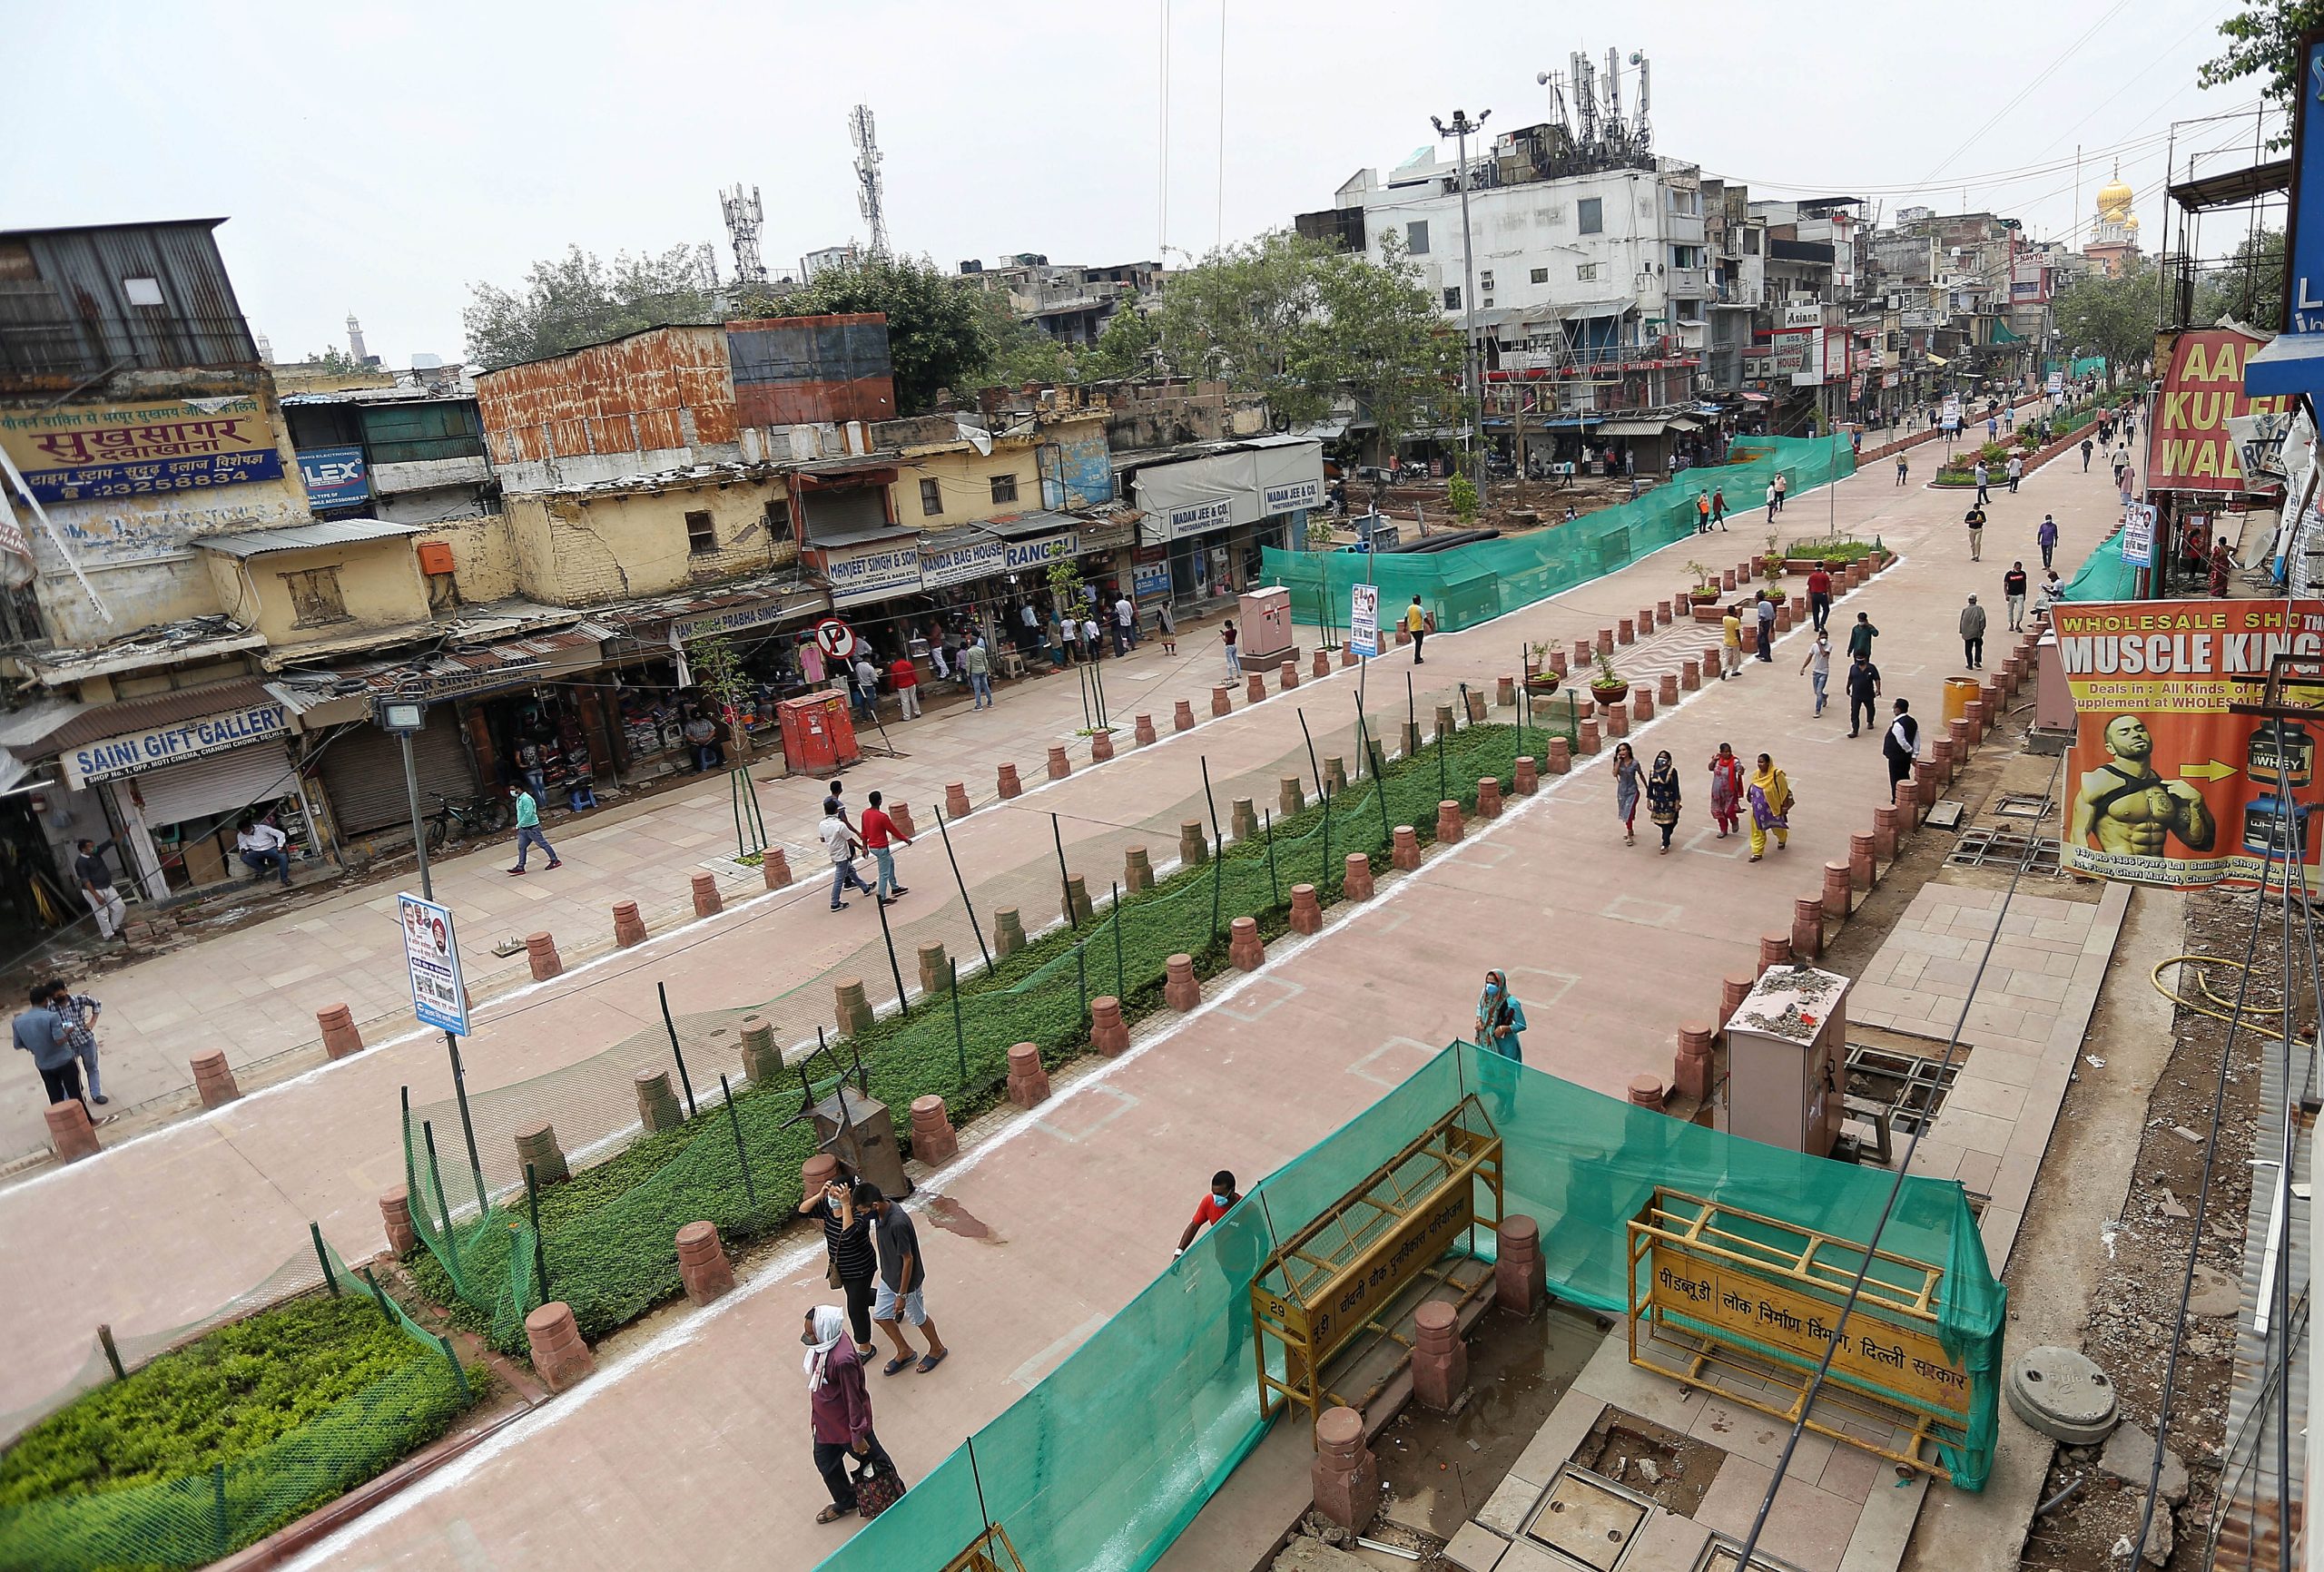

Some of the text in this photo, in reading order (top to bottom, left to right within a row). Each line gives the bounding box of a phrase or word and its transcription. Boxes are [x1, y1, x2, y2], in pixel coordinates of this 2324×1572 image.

[2020, 253, 2043, 261] NAVYA
[1787, 312, 1818, 324] Asiana
[1777, 358, 1800, 368] HOUSE
[29, 418, 252, 465] सुखसागर
[96, 439, 221, 461] दवाखाना
[316, 451, 360, 459] ELECTRONICS
[2162, 439, 2242, 478] WAL
[169, 458, 209, 475] इलाज
[326, 496, 359, 505] ACCESSORIES
[1266, 485, 1316, 504] MADAN JEE & CO.
[1272, 499, 1301, 510] PHOTOGRAPHIC
[1172, 503, 1228, 526] MADAN JEE & CO.
[1177, 517, 1224, 533] PHOTOGRAPHIC STORE
[921, 553, 952, 573] NANDA
[953, 548, 971, 565] BAG
[972, 542, 1002, 561] HOUSE
[1006, 535, 1078, 566] RANGOLI
[830, 559, 866, 579] MANJEET
[868, 555, 892, 572] SINGH
[893, 552, 901, 567] &
[901, 550, 917, 566] SON
[862, 576, 886, 585] UNIFORM
[723, 610, 756, 628] PRABHA
[757, 604, 783, 622] SINGH
[2062, 614, 2227, 632] WHOLESALE
[2061, 632, 2322, 674] MUSCLE KING
[2089, 683, 2127, 694] Deals
[2132, 683, 2143, 694] in
[2162, 683, 2179, 694] All
[2184, 683, 2225, 694] Kinds
[2235, 683, 2249, 694] of
[2071, 696, 2150, 710] Supplement
[2154, 698, 2168, 708] at
[76, 705, 286, 774] SAINI GIFT GALLERY
[89, 773, 109, 783] SHOP
[133, 763, 151, 772] OPP.
[151, 758, 170, 767] MOTI
[171, 751, 201, 762] CINEMA,
[202, 742, 231, 755] CHANDNI
[233, 736, 260, 748] CHOWK,
[2111, 856, 2135, 866] 1486
[2137, 858, 2166, 870] Pyare
[2168, 861, 2185, 870] Lal
[2232, 859, 2260, 870] Shop
[2088, 863, 2113, 877] Floor,
[2116, 868, 2142, 879] Ghari
[2144, 871, 2182, 885] Market,
[1369, 1265, 1387, 1289] चौक
[1429, 1196, 1465, 1235] परियोजना
[1270, 1301, 1285, 1317] 29
[1723, 1292, 1752, 1315] लोक
[1758, 1302, 1802, 1333] निर्माण
[1860, 1337, 1906, 1370] दिल्ली
[1912, 1358, 1968, 1390] सरकार
